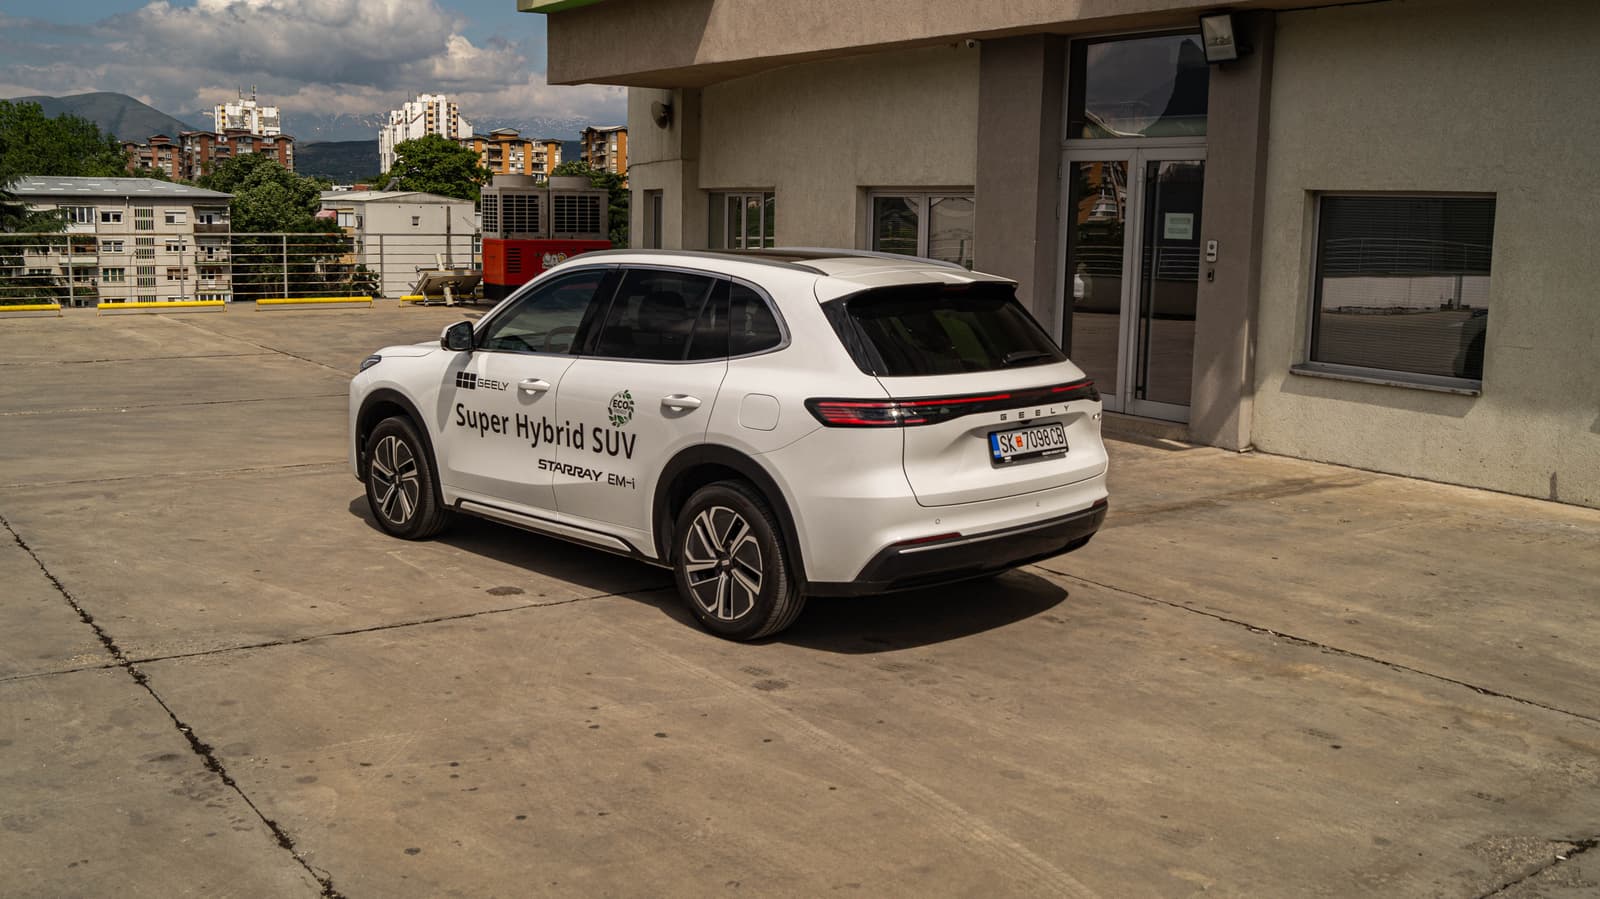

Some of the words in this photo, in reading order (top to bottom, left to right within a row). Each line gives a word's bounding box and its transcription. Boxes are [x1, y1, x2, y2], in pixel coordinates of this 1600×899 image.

[477, 378, 509, 392] GEELY
[612, 399, 629, 410] ECO
[1000, 405, 1070, 421] GEELY
[456, 403, 509, 438] Super
[516, 413, 584, 450] Hybrid
[592, 427, 637, 460] SUV
[1000, 433, 1016, 453] SK
[538, 459, 603, 482] STARRAY
[607, 473, 636, 490] EM-i
